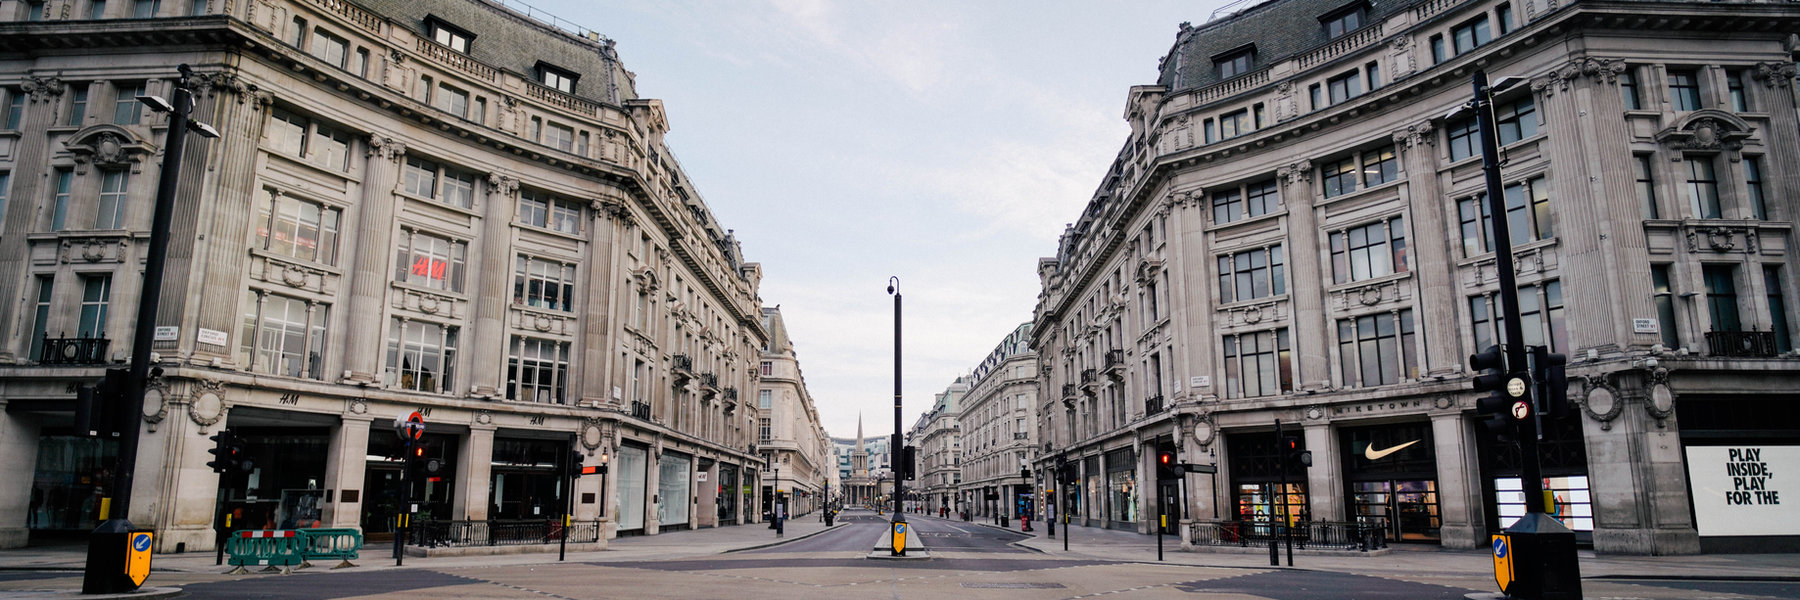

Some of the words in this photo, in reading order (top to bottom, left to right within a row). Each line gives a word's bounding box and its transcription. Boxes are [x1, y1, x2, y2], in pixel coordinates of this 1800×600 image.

[412, 257, 447, 280] H&M
[279, 393, 300, 406] H&M
[417, 407, 432, 418] H&M
[1336, 400, 1420, 414] NIKETOWN
[530, 416, 545, 426] H&M
[1728, 448, 1761, 462] PLAY
[1726, 462, 1773, 479] INSIDE,
[1733, 476, 1766, 491] PLAY
[1726, 491, 1753, 505] FOR
[1754, 491, 1780, 505] THE
